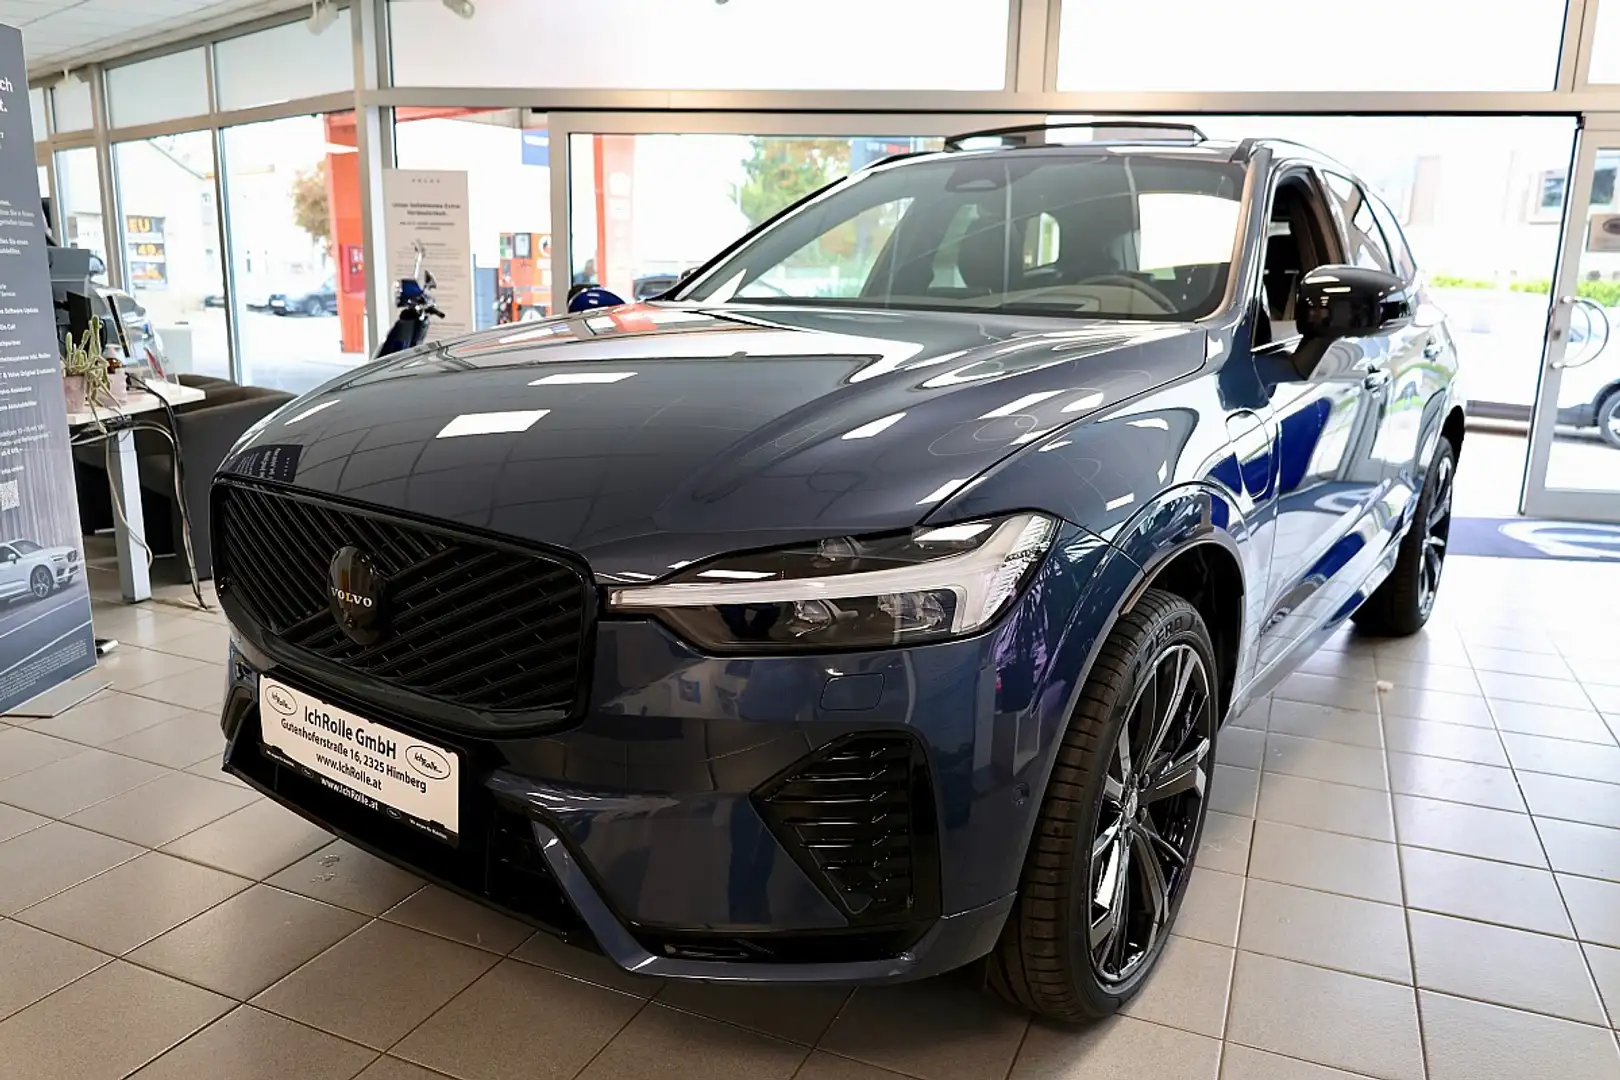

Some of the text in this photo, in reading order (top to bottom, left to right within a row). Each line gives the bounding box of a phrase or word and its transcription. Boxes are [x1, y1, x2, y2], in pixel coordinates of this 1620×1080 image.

[331, 586, 373, 608] VOLVO
[304, 705, 397, 760] IchRolle GmbH
[280, 718, 427, 794] Gutenhoferstraße 16, 2325 Himberg
[316, 753, 382, 791] www.IchRolle.at
[321, 778, 379, 811] www.IchRolle.at
